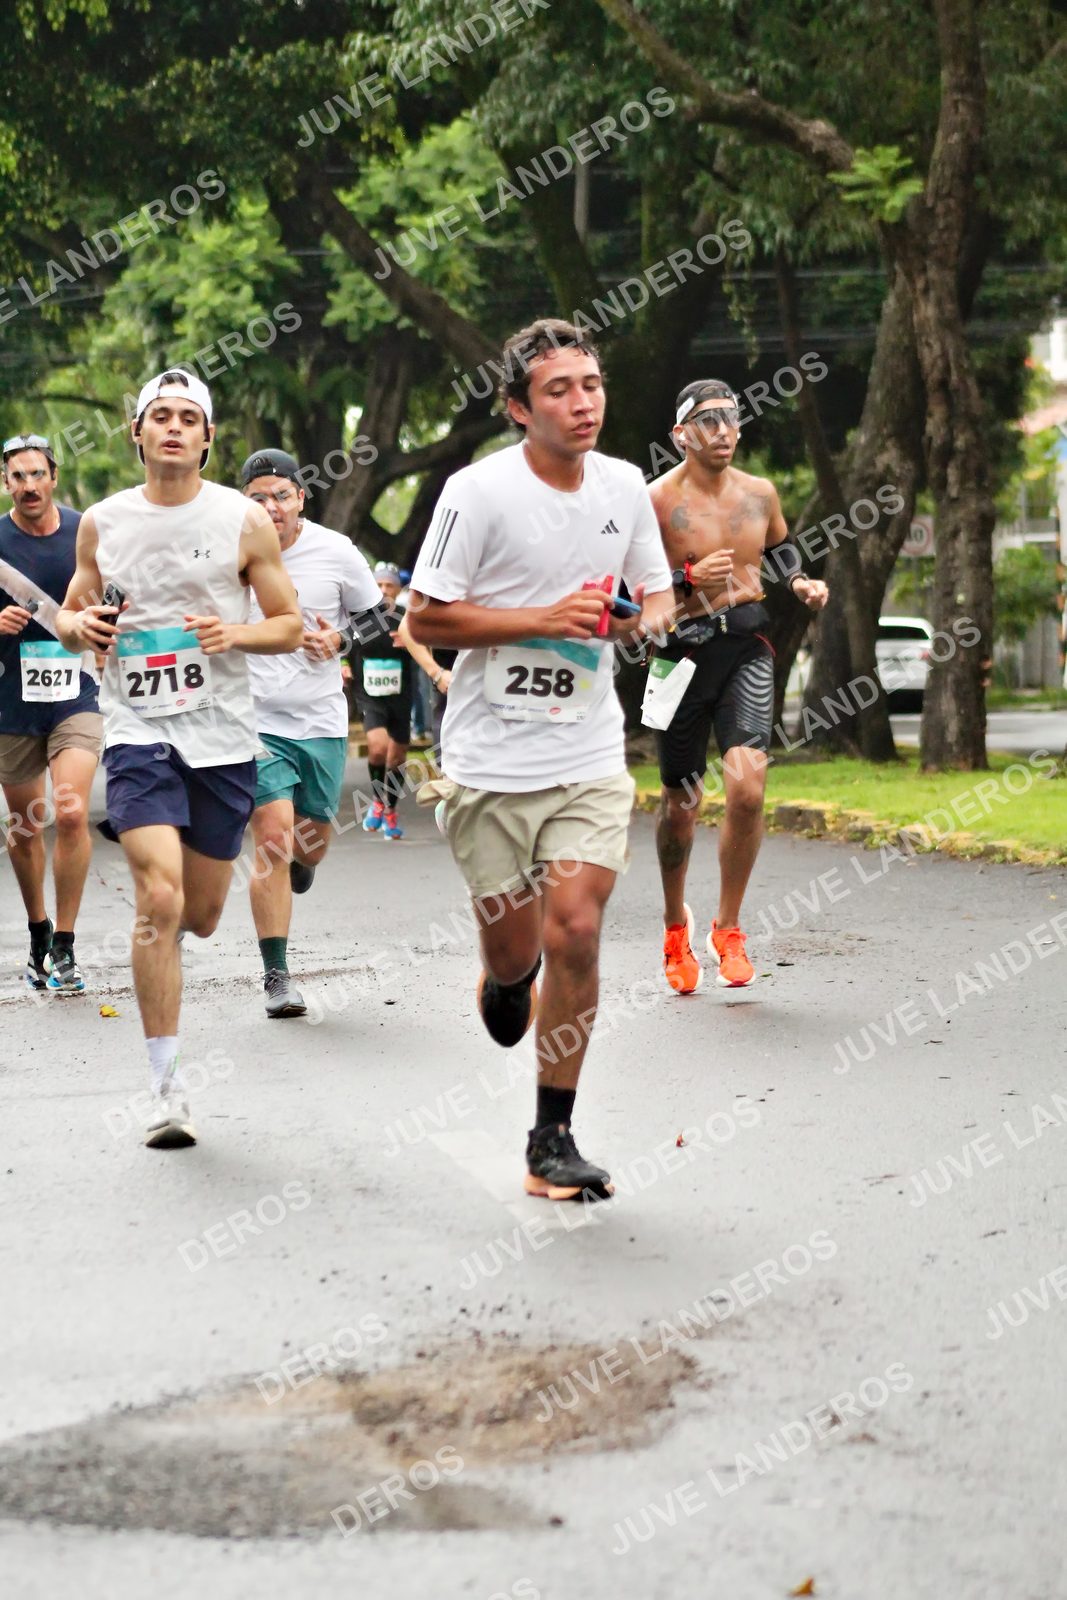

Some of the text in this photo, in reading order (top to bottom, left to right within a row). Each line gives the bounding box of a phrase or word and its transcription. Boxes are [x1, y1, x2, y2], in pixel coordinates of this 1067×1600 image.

[26, 668, 73, 688] 2621
[126, 663, 205, 698] 2718
[504, 665, 575, 698] 258
